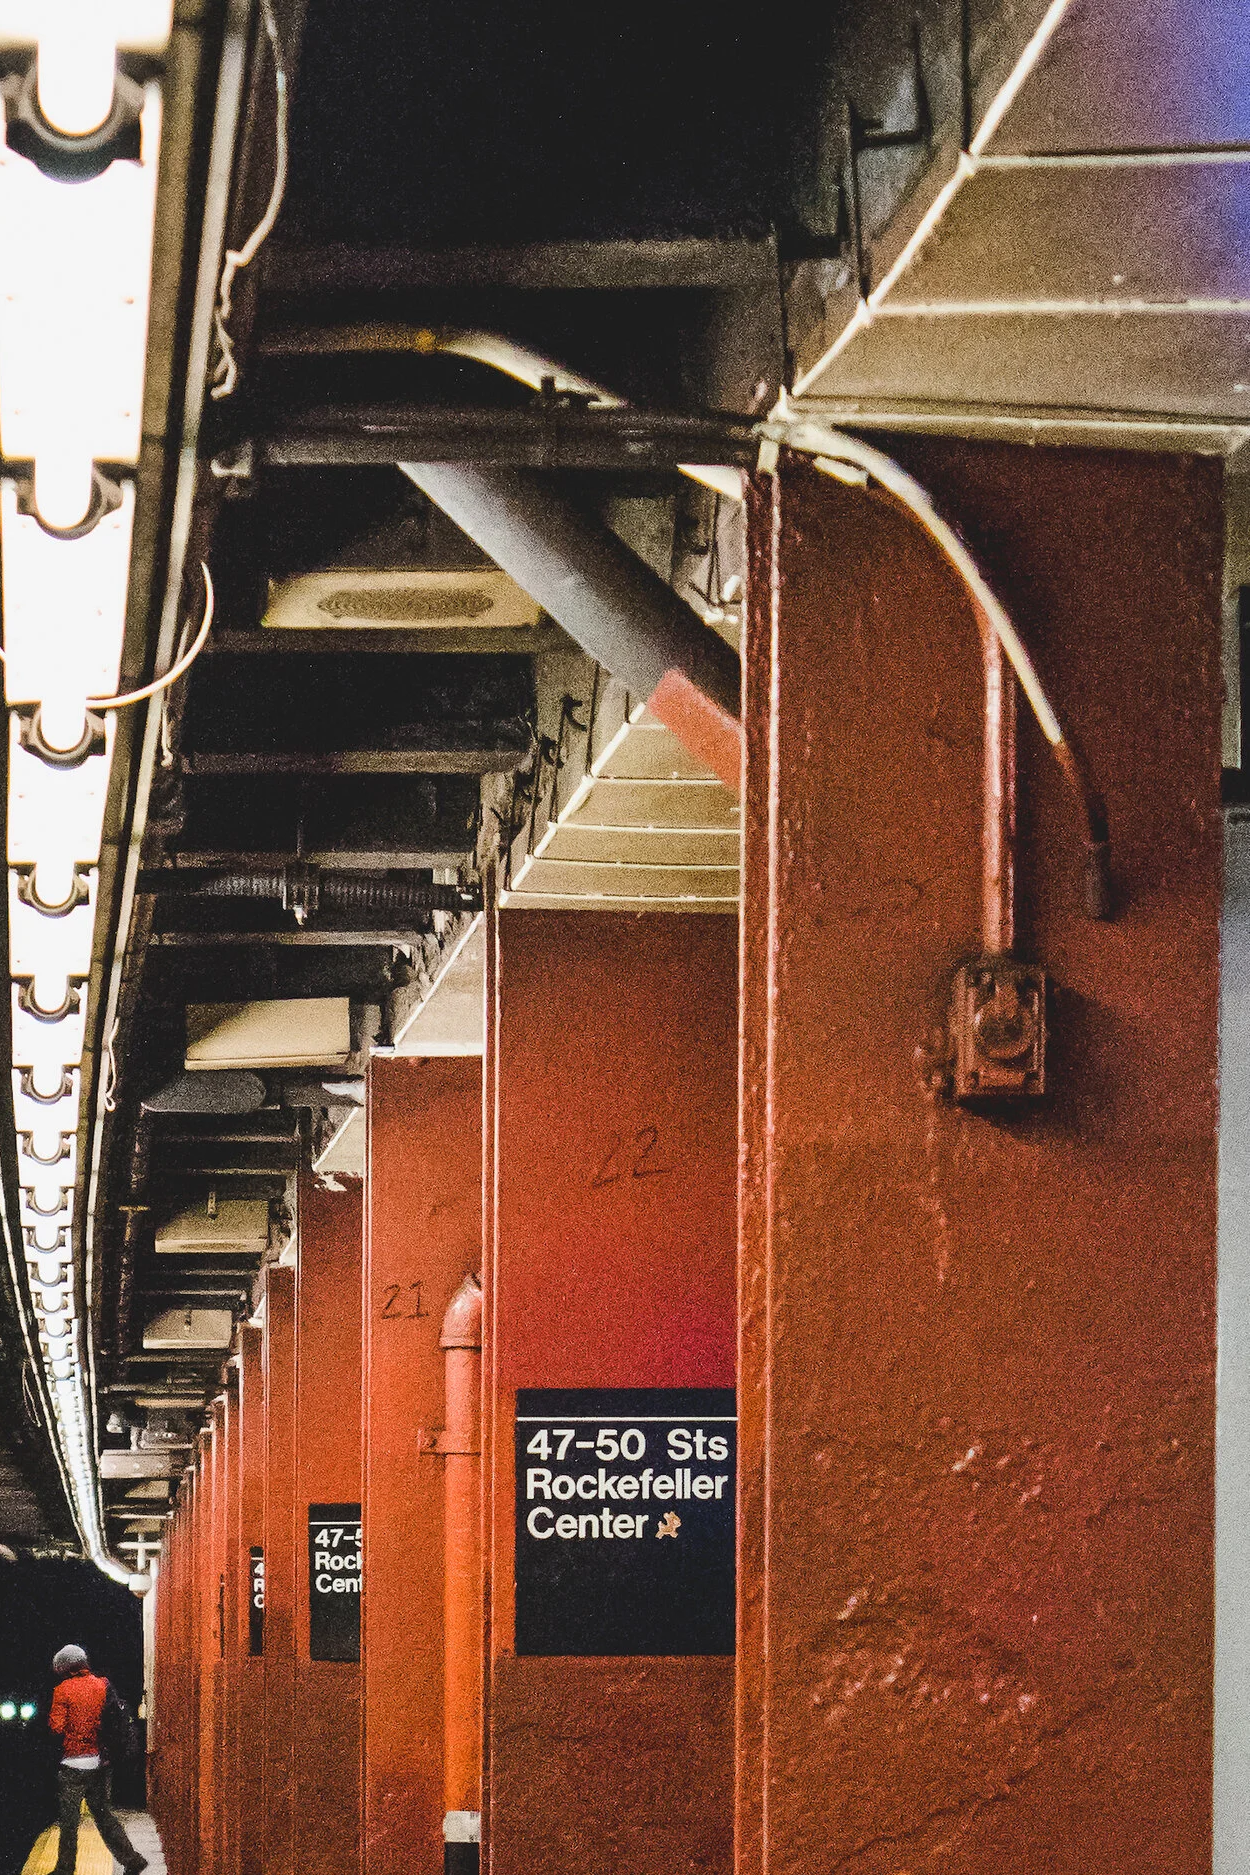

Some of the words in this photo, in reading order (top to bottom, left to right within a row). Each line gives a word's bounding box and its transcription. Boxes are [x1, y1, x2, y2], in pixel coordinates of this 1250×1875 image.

[381, 1280, 430, 1320] 21
[527, 1428, 645, 1461] 47-50
[667, 1428, 729, 1461] Sts
[526, 1468, 729, 1500] Rockefeller
[526, 1505, 649, 1539] Center
